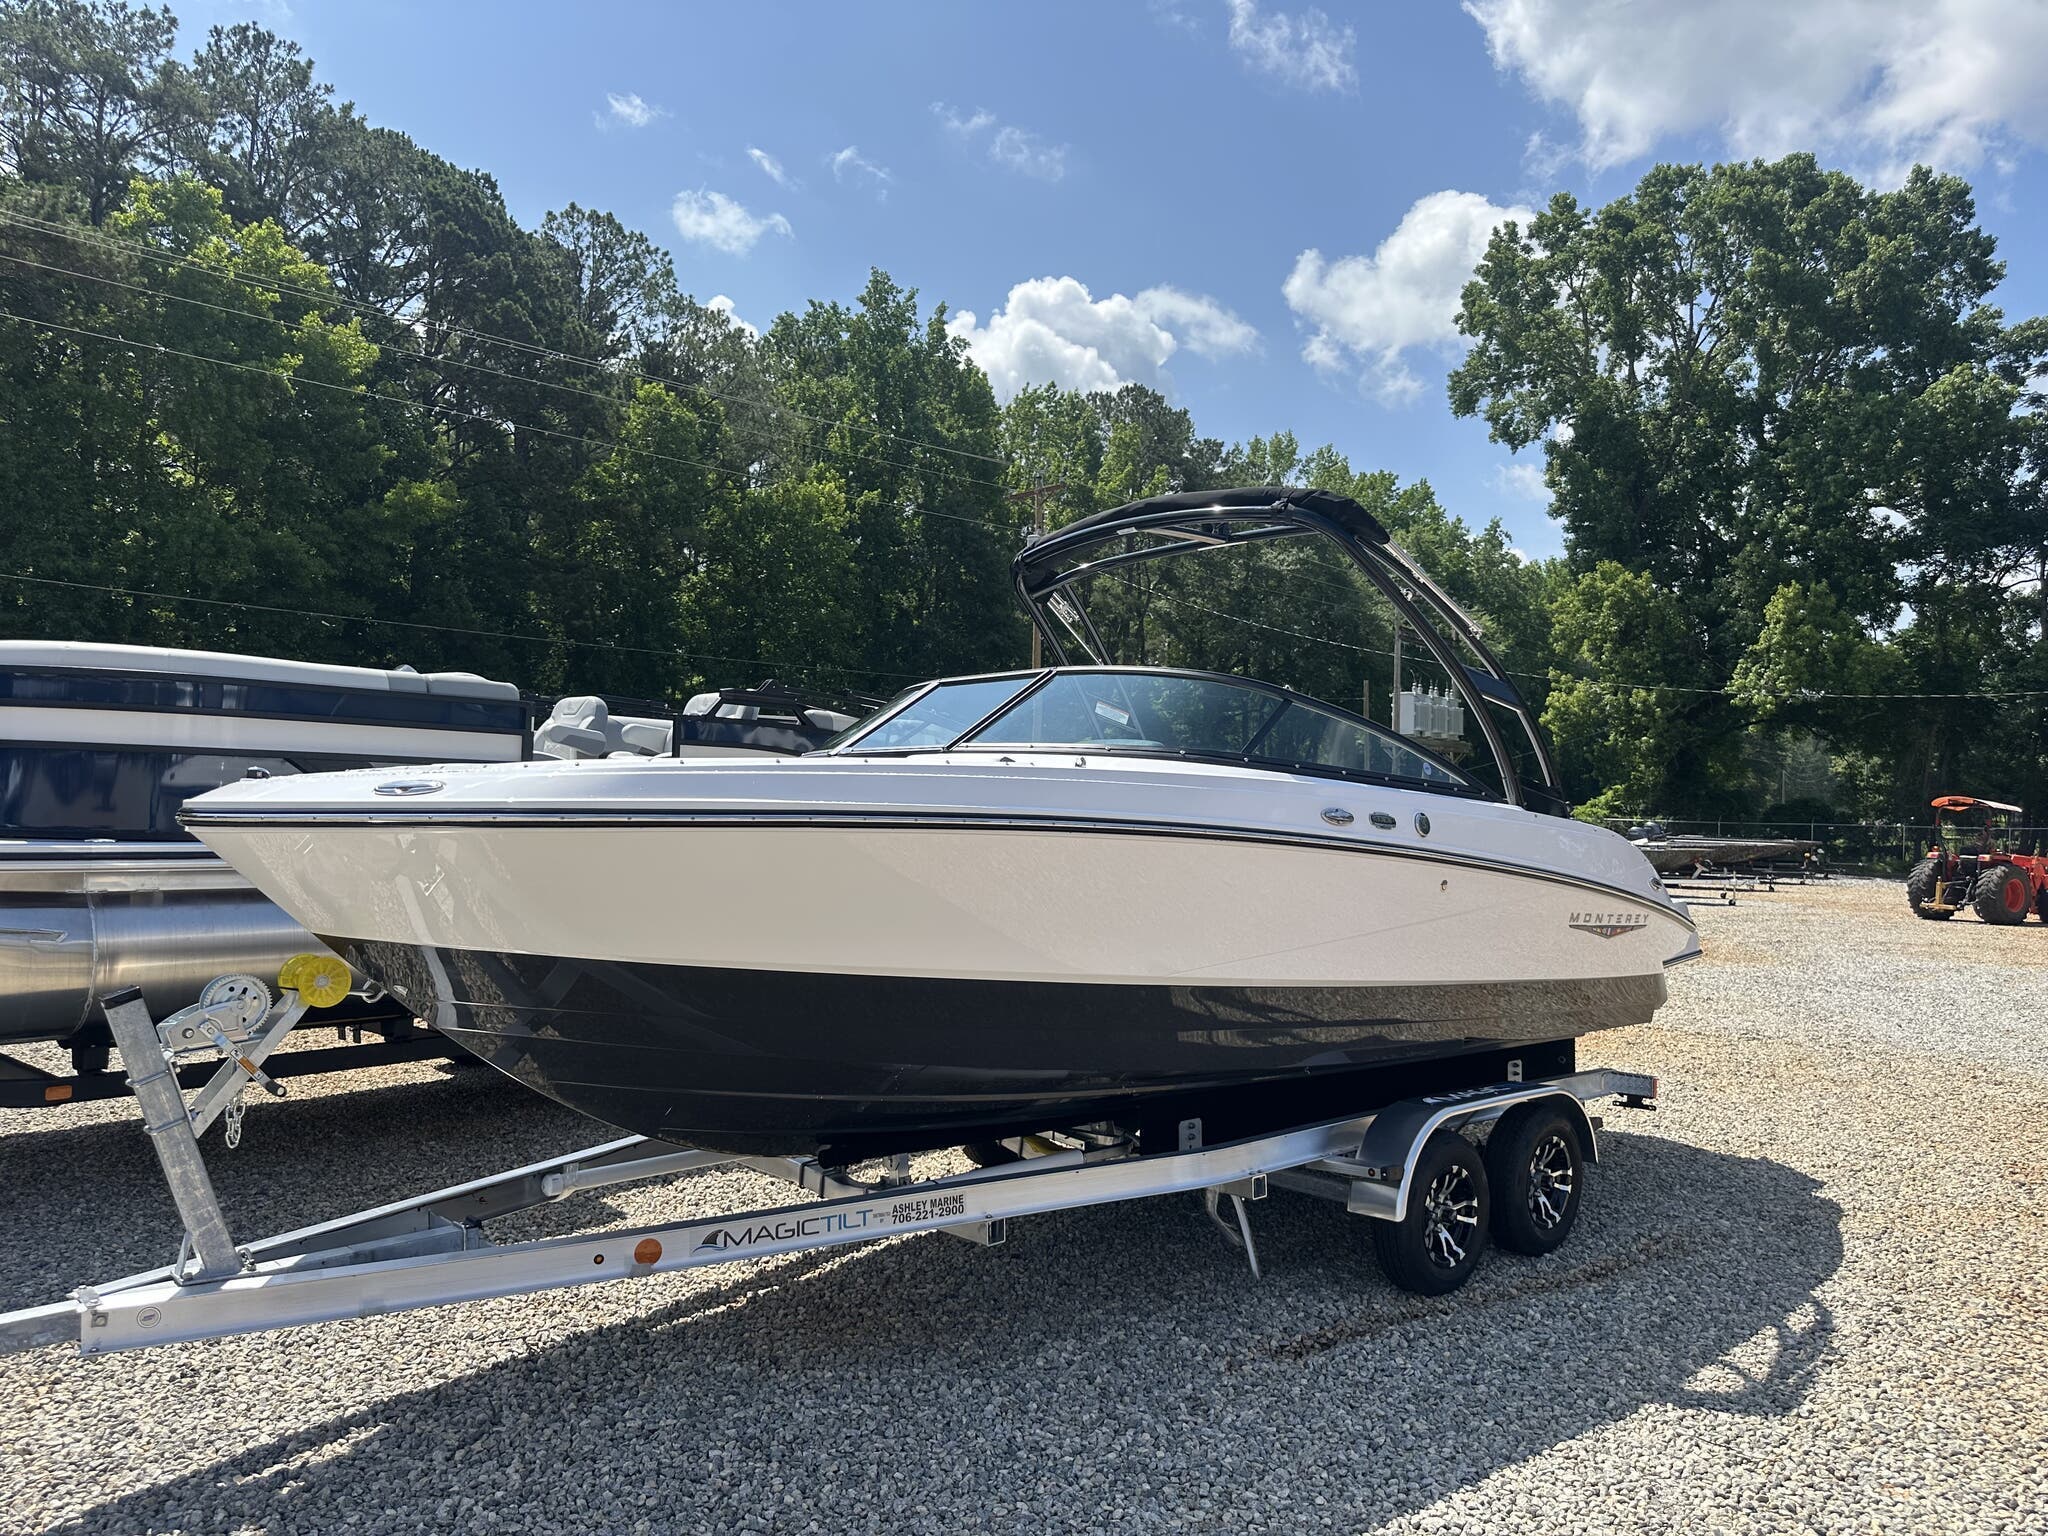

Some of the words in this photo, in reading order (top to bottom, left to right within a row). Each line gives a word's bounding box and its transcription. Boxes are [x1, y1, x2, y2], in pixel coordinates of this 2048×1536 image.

[1568, 912, 1650, 924] MONTEREY
[892, 1199, 928, 1215] ASHLEY
[930, 1194, 965, 1209] MARINE
[892, 1204, 965, 1225] 706-221-2900
[723, 1208, 874, 1248] MAGICTILT
